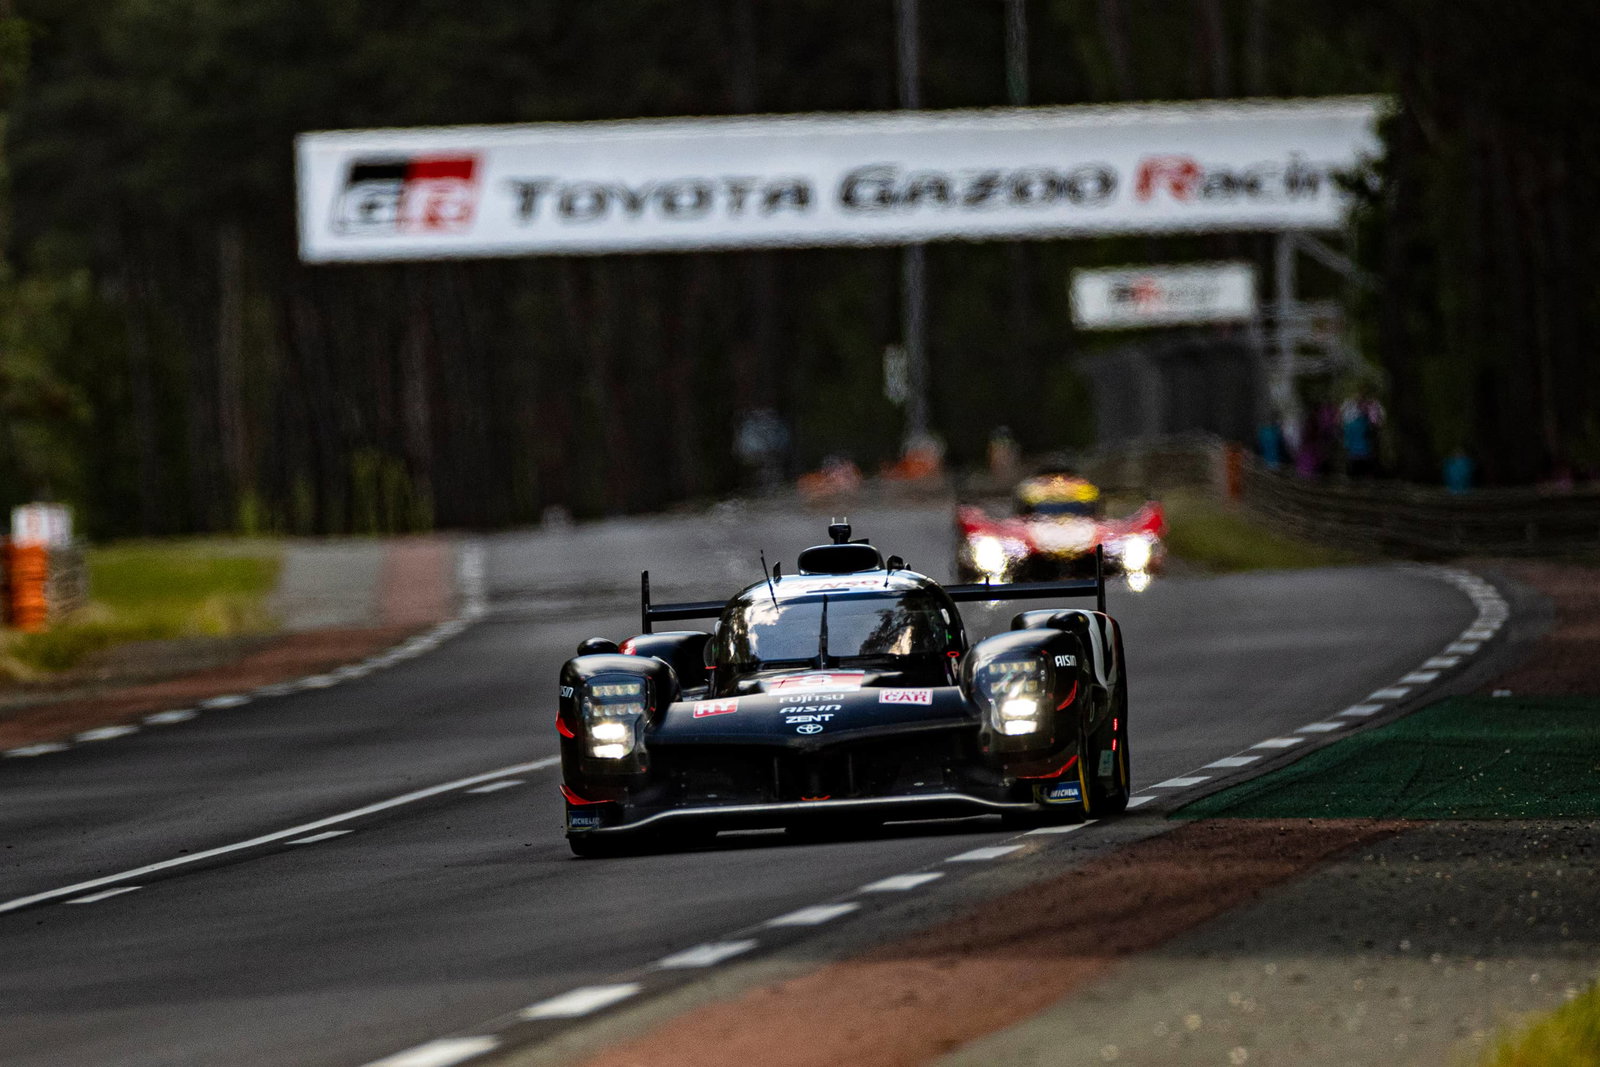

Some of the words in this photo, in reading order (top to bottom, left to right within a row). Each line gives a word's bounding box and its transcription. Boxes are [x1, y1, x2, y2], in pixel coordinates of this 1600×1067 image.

[503, 173, 812, 226] TOYOTA
[838, 160, 1119, 215] GAZOO
[1136, 152, 1344, 204] Racin
[779, 693, 845, 703] FUJITSU
[884, 694, 927, 702] CAR
[696, 701, 736, 715] HY
[785, 713, 835, 724] ZENT
